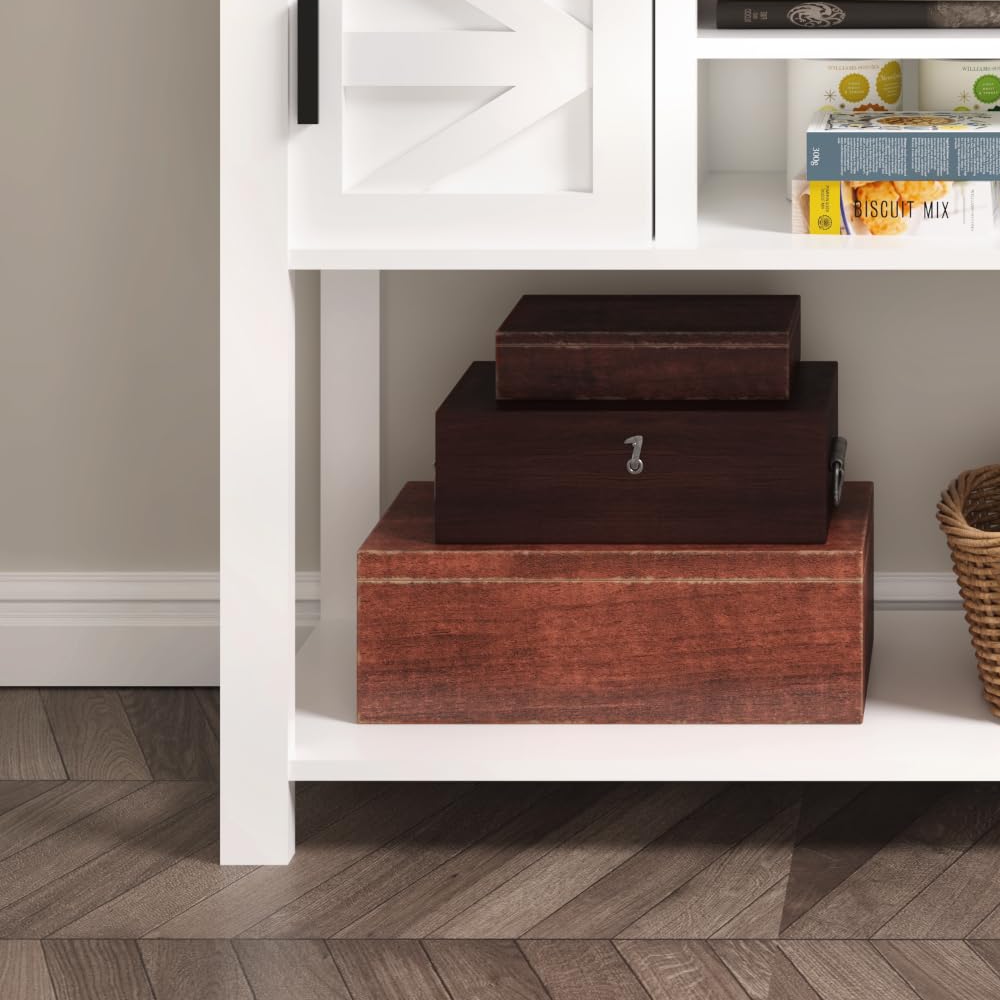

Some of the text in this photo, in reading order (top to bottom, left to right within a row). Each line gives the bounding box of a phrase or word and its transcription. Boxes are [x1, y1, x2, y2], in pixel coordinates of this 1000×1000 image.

[810, 146, 820, 166] 300g
[854, 200, 914, 219] BISCUIT
[923, 201, 949, 219] MIX
